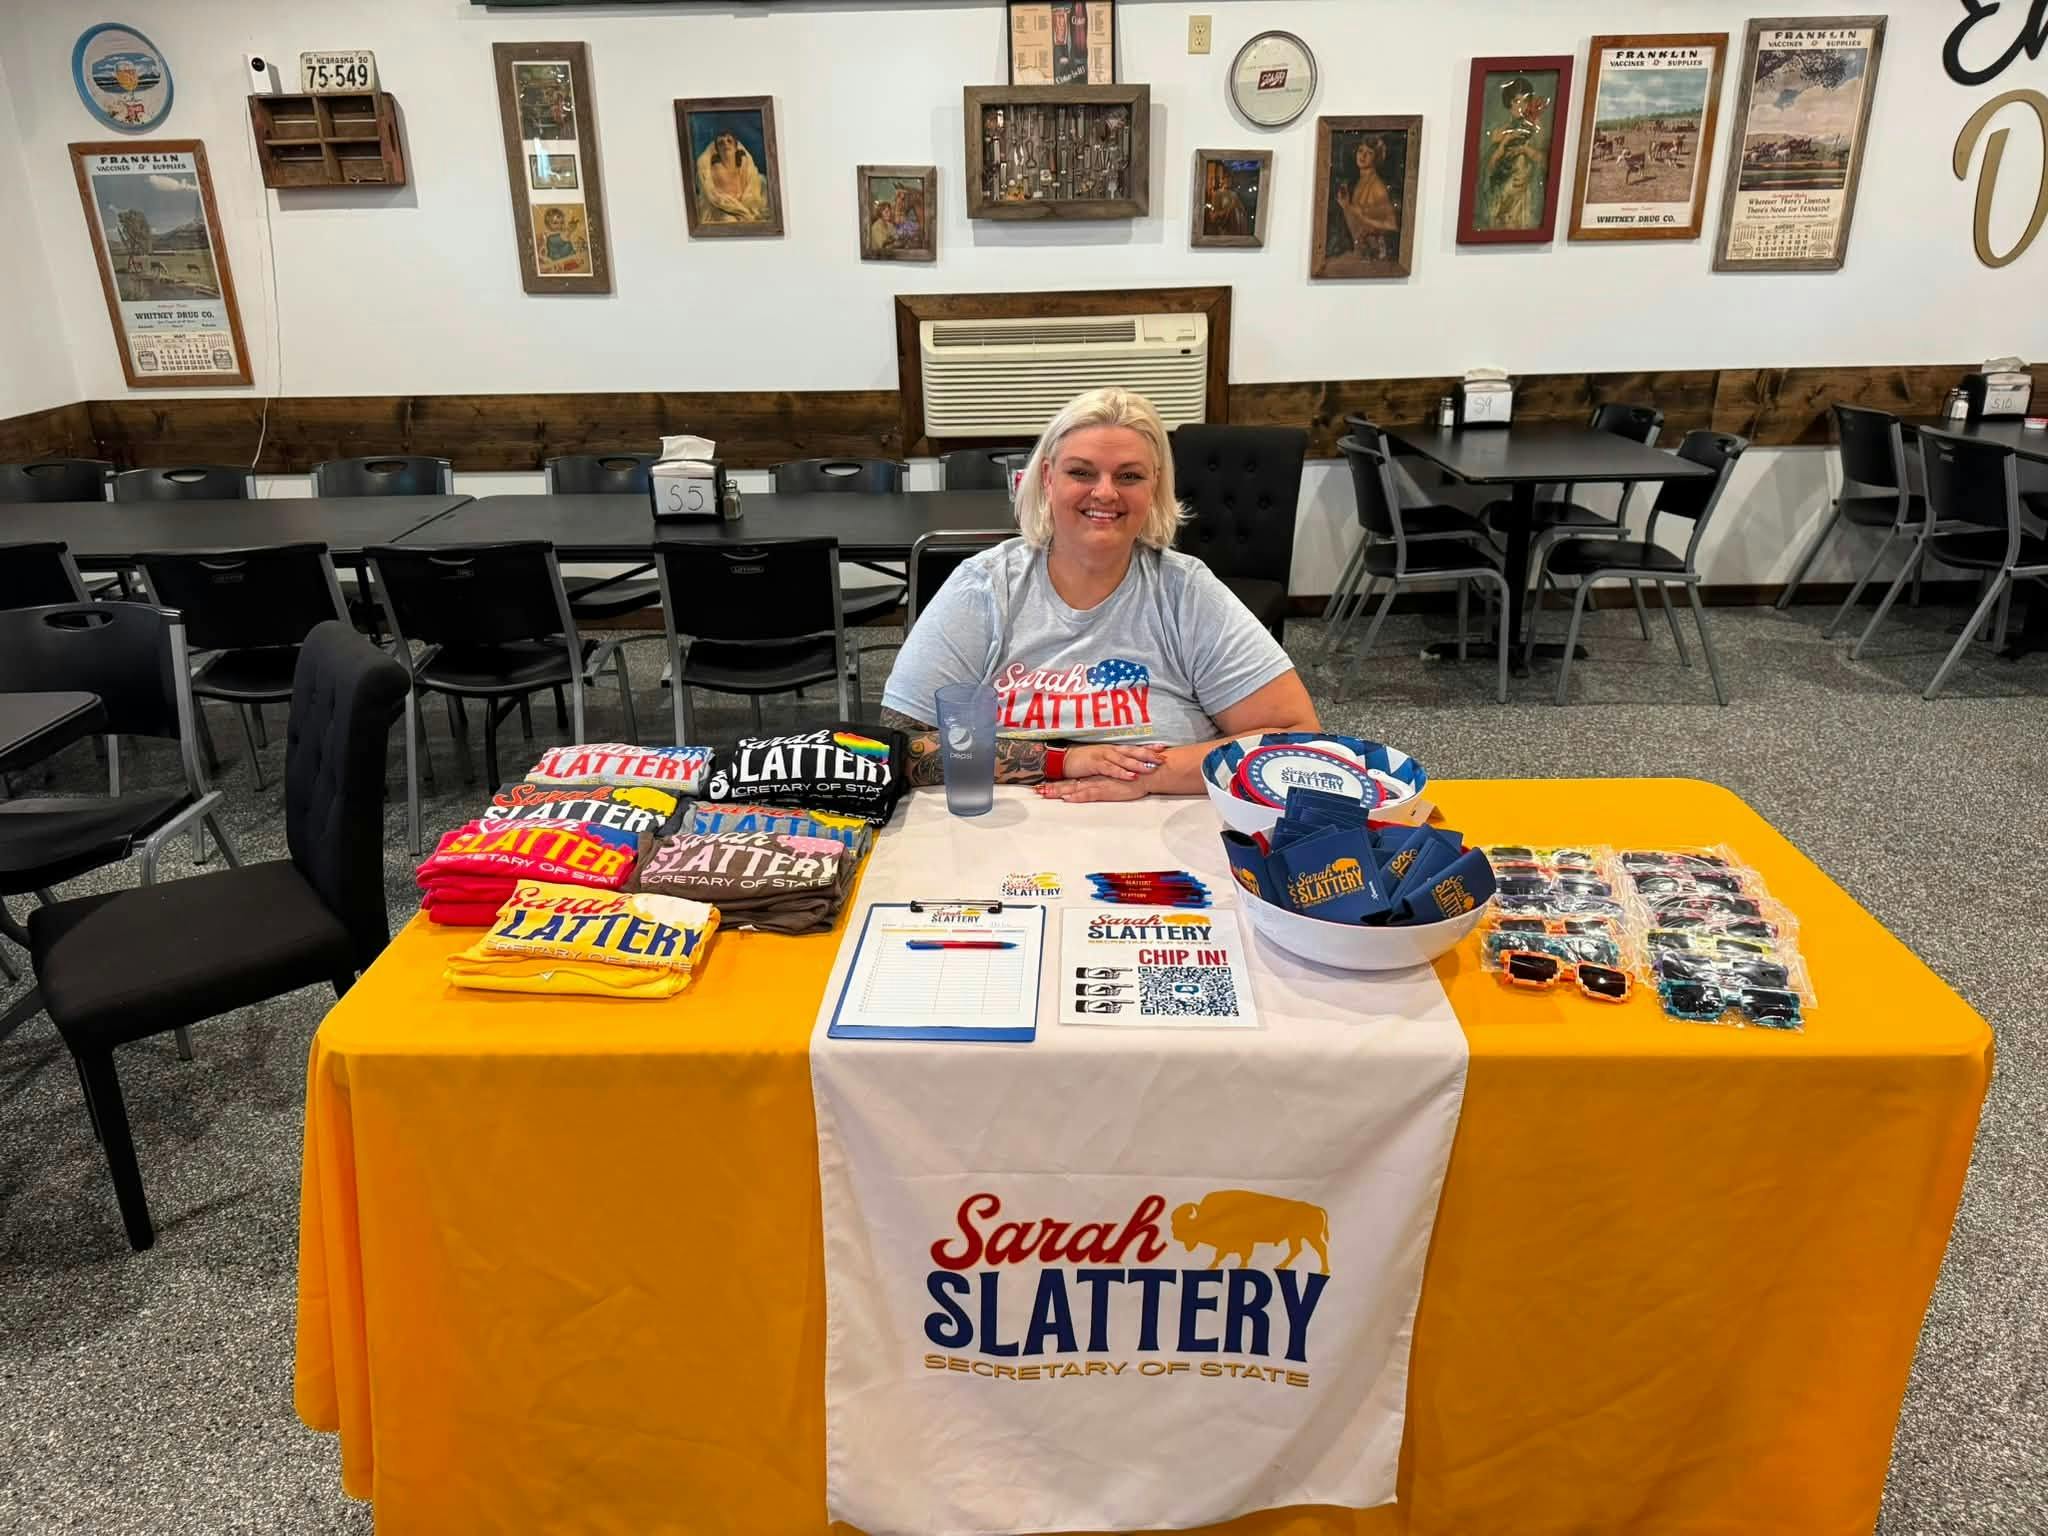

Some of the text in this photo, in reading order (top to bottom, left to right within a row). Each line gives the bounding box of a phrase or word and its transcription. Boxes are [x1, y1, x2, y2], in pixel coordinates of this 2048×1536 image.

[1775, 30, 1857, 39] FRANKLIN
[1616, 50, 1698, 59] FRANKLIN
[100, 154, 179, 164] FRANKLIN
[1597, 215, 1636, 224] WHITNEY
[1638, 215, 1661, 223] DRUG
[135, 311, 174, 320] WHITNEY
[176, 311, 200, 319] DRUG
[993, 663, 1084, 692] Sarah
[816, 783, 841, 791] OF
[1281, 771, 1344, 791] SLATTERY
[539, 862, 568, 874] OF
[1297, 864, 1333, 886] Sarah
[739, 879, 768, 889] OF
[772, 878, 833, 889] STATE
[1298, 870, 1364, 903] SLATTERY
[1006, 888, 1061, 897] SLATTERY
[509, 887, 633, 915] Sarah
[931, 915, 981, 923] SLATTERY
[1090, 913, 1163, 926] Sarah
[1088, 925, 1212, 941] SLATTERY
[1138, 949, 1228, 966] CHIP IN!
[930, 1192, 1169, 1271] Sarah
[924, 1267, 1331, 1363] SLATTERY
[924, 1351, 1311, 1388] SECRETARY OF STATE
